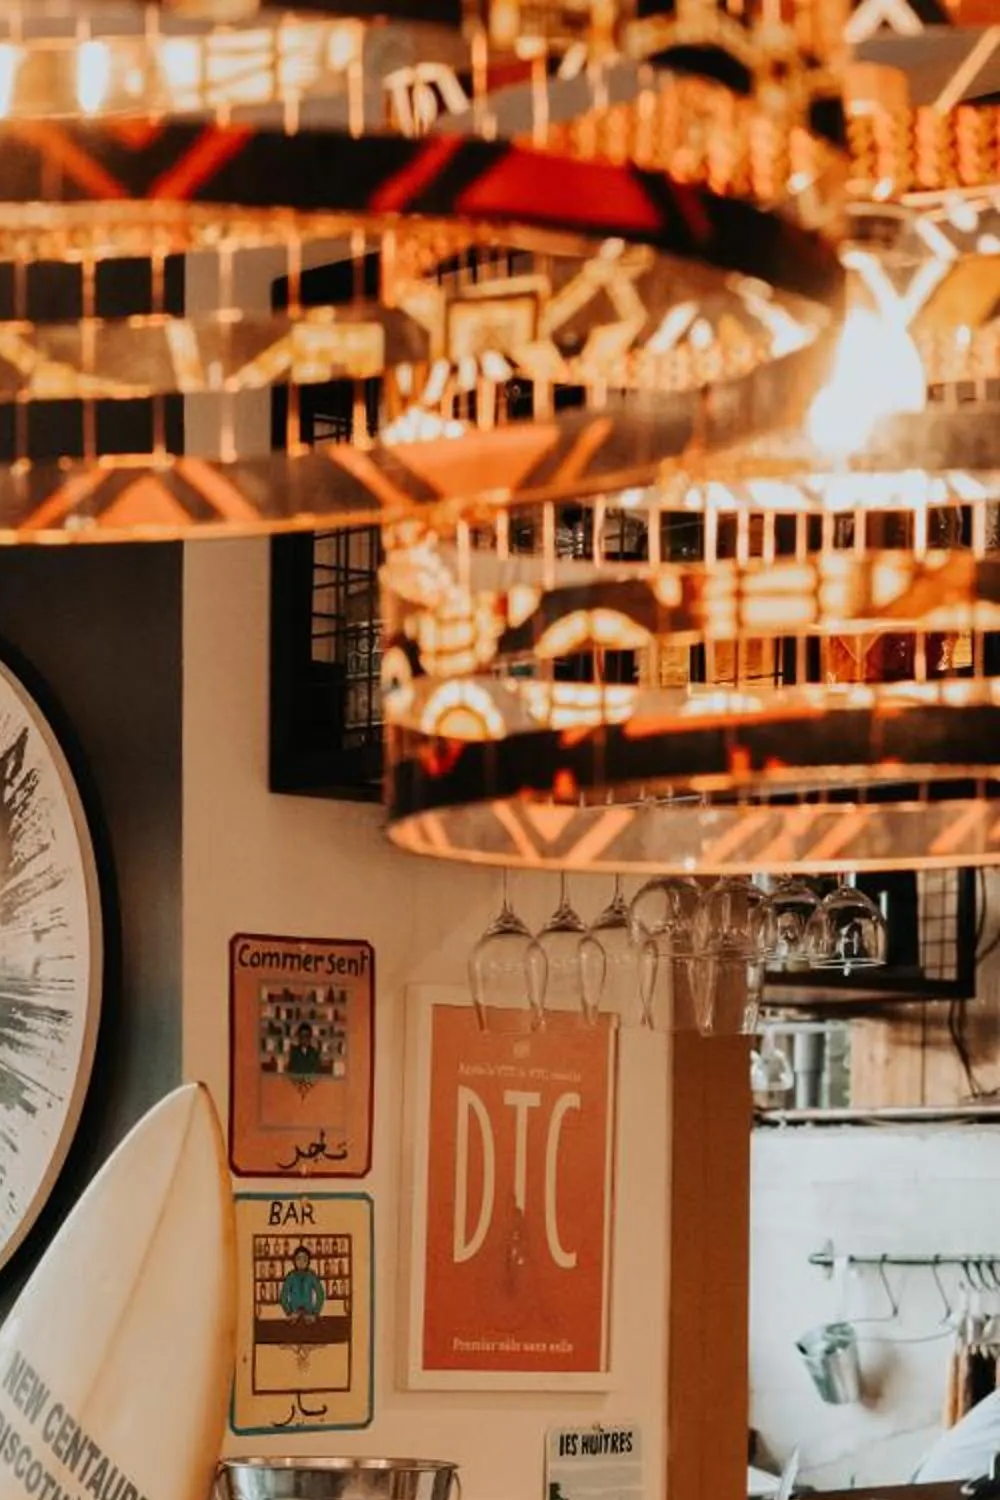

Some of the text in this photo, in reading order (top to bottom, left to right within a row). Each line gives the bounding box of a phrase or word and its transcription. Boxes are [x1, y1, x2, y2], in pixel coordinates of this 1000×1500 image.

[268, 1201, 316, 1226] BAR
[453, 1084, 581, 1269] DTC
[3, 1350, 51, 1424] NEW
